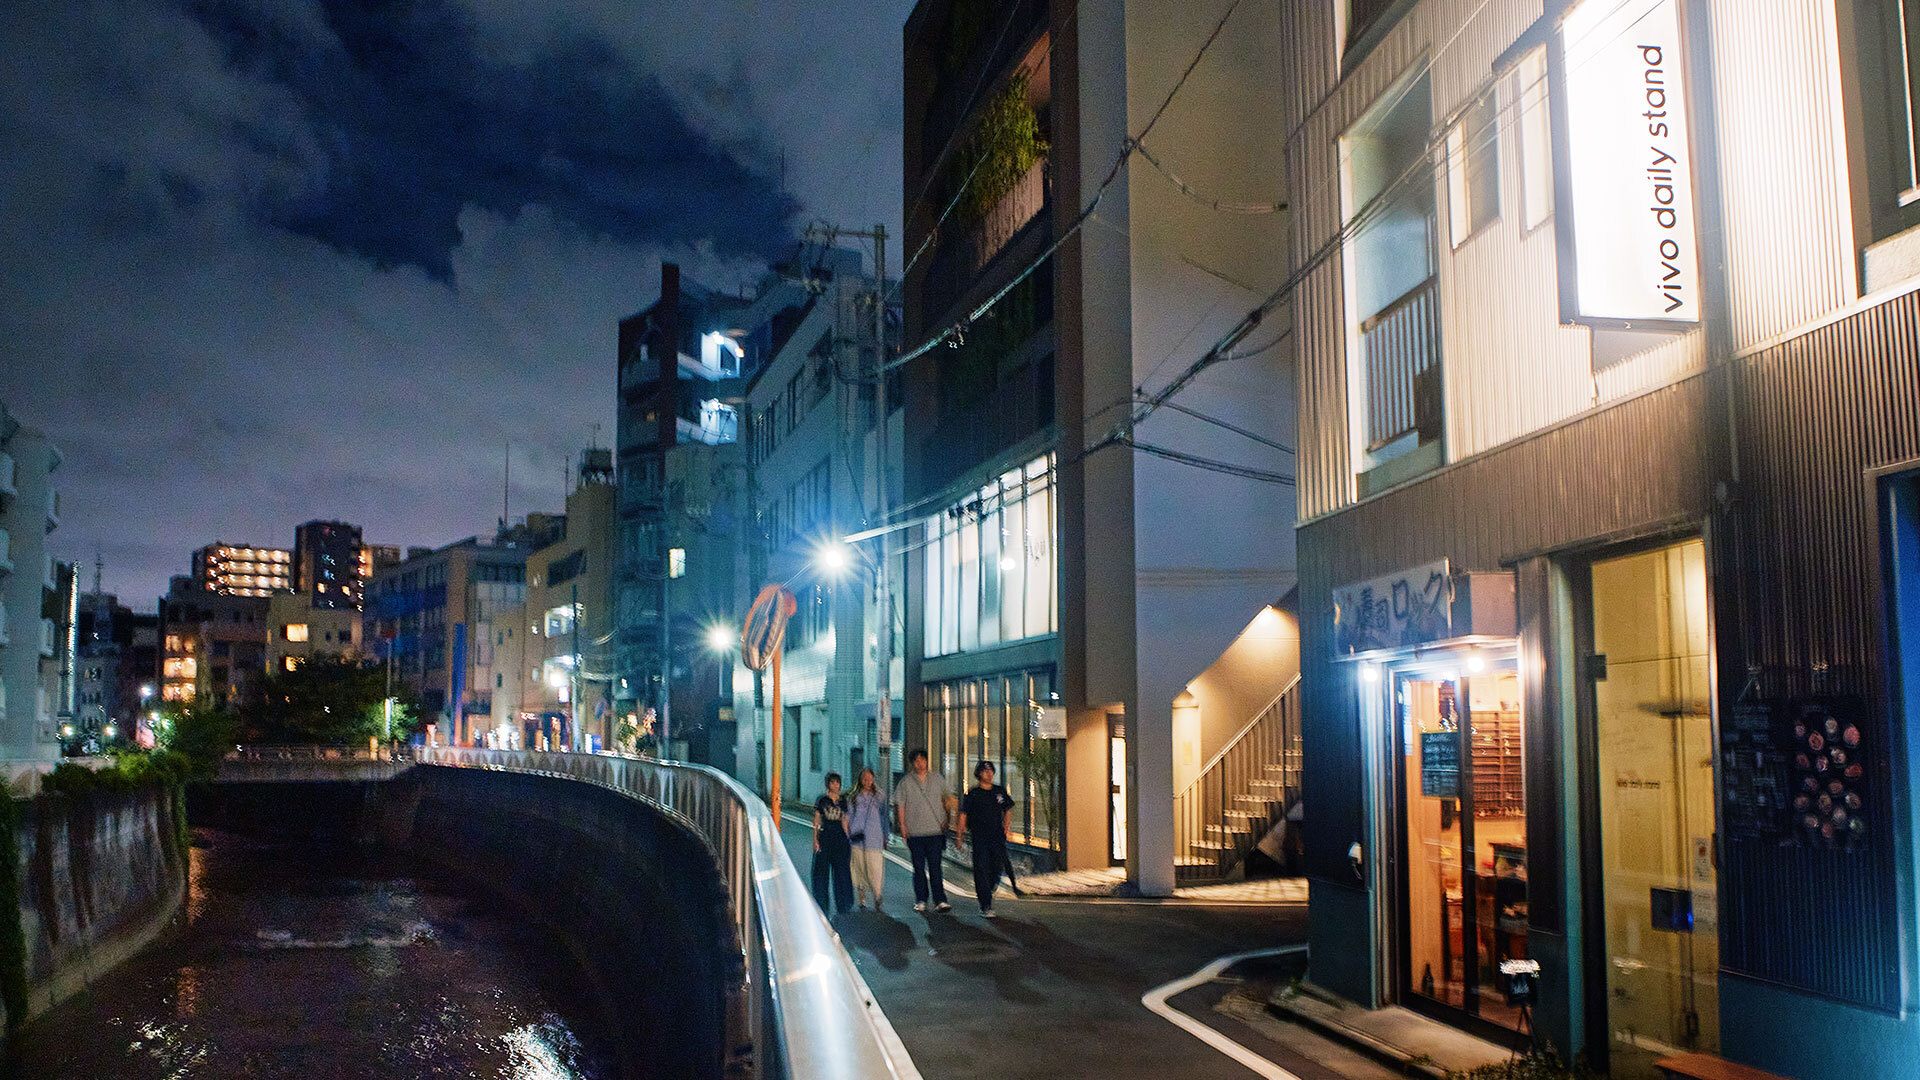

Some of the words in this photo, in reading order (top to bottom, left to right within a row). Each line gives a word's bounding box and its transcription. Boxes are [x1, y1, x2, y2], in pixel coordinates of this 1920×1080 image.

[1637, 45, 1668, 138] stand
[1646, 146, 1677, 229] daily
[1656, 239, 1683, 313] vivo
